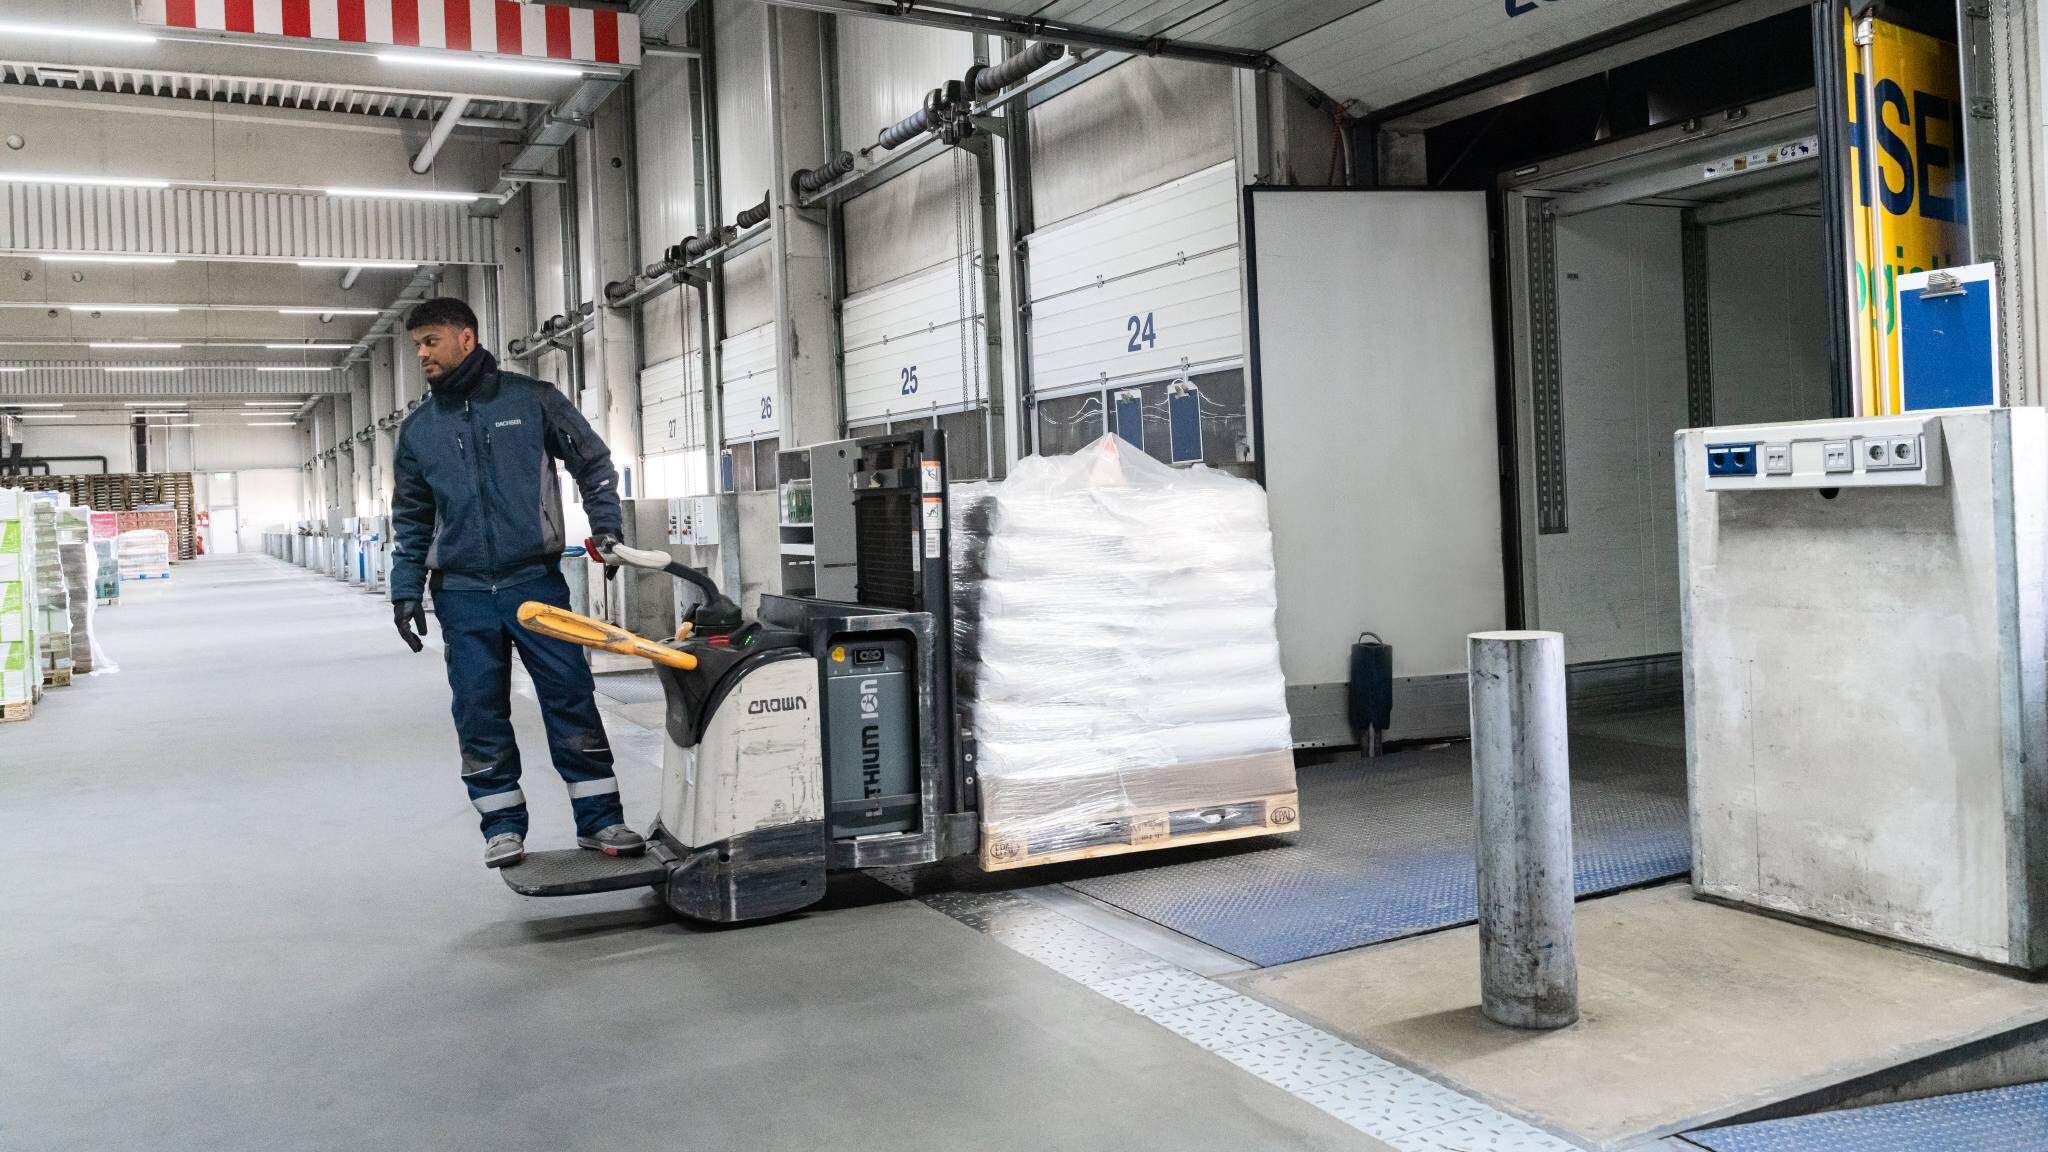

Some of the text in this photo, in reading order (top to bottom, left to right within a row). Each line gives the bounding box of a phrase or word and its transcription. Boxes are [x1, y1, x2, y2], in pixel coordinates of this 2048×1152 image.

[1127, 312, 1157, 352] 24
[901, 365, 918, 395] 25
[761, 396, 772, 419] 26
[668, 419, 677, 438] 27
[748, 695, 807, 714] CROWN
[861, 725, 883, 818] LTHIUM
